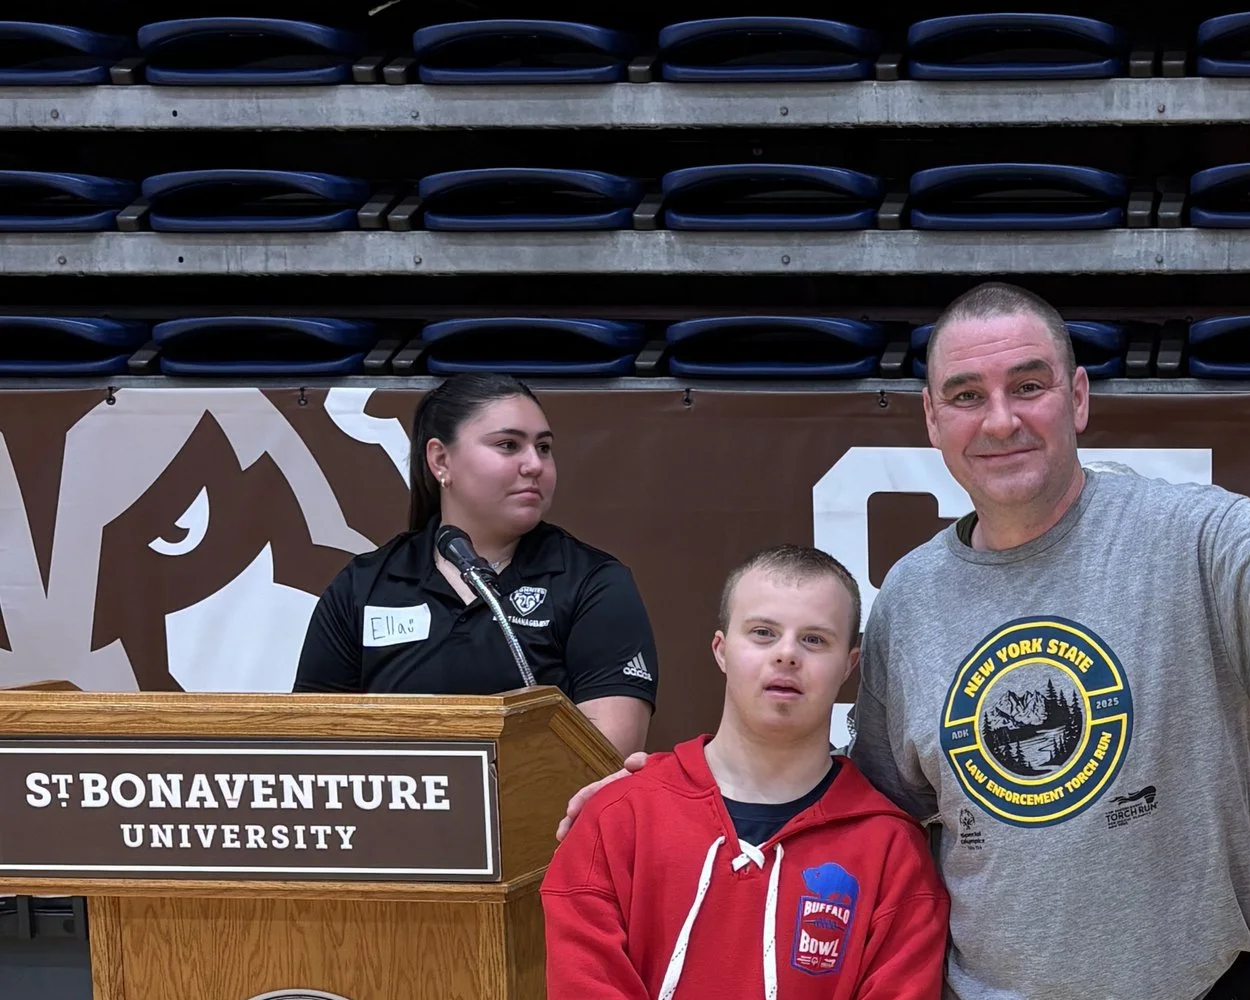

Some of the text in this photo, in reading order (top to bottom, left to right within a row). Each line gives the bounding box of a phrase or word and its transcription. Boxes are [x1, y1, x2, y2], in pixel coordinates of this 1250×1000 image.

[371, 615, 407, 641] Ella
[963, 637, 1094, 698] NEW YORK STATE
[1095, 697, 1120, 709] 2025
[951, 729, 970, 741] ADK
[964, 731, 1112, 806] LAW ENFORCEMENT TORCH RUN
[79, 772, 451, 811] BONAVENTURE
[1105, 807, 1139, 823] TORCH
[1139, 802, 1157, 815] RUN
[120, 823, 357, 851] UNIVERSITY
[803, 900, 850, 925] BUFFALO
[798, 929, 840, 957] BOWL
